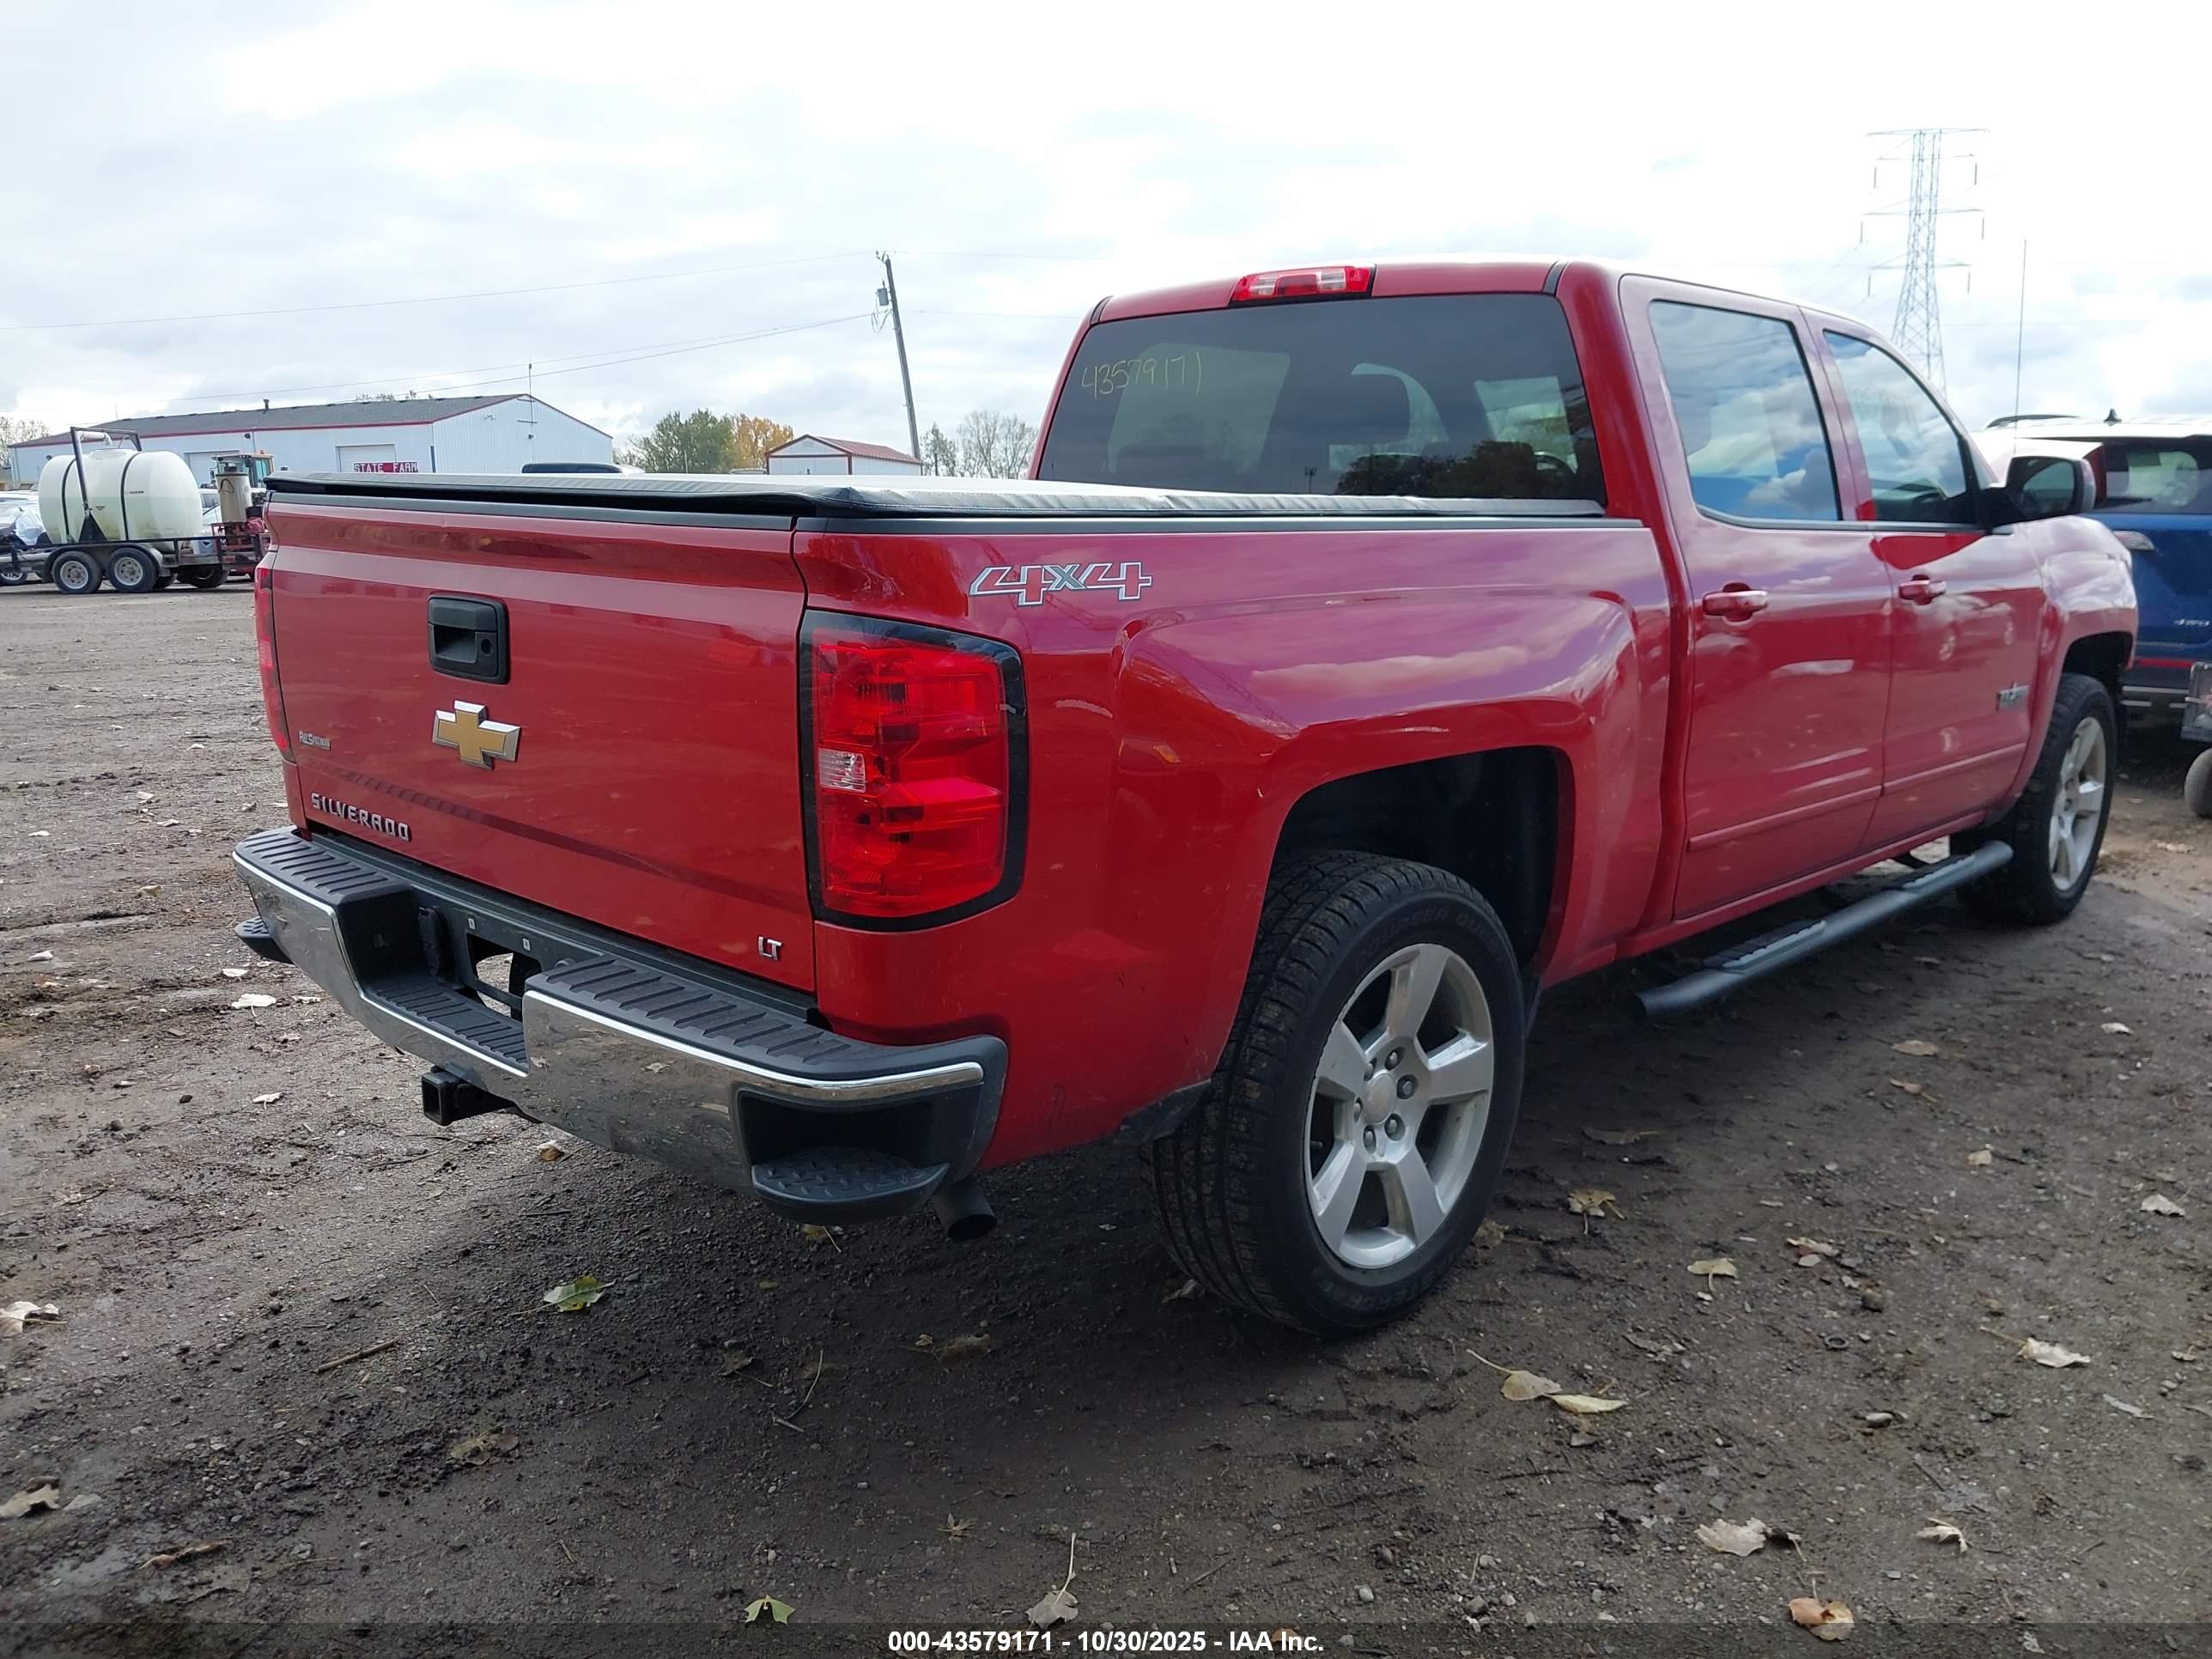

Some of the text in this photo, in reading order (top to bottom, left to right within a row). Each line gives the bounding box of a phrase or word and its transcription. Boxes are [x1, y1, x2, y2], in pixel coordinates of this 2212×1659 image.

[354, 462, 419, 473] STATE FARM
[310, 792, 410, 842] SILVERADO
[757, 936, 782, 961] LT
